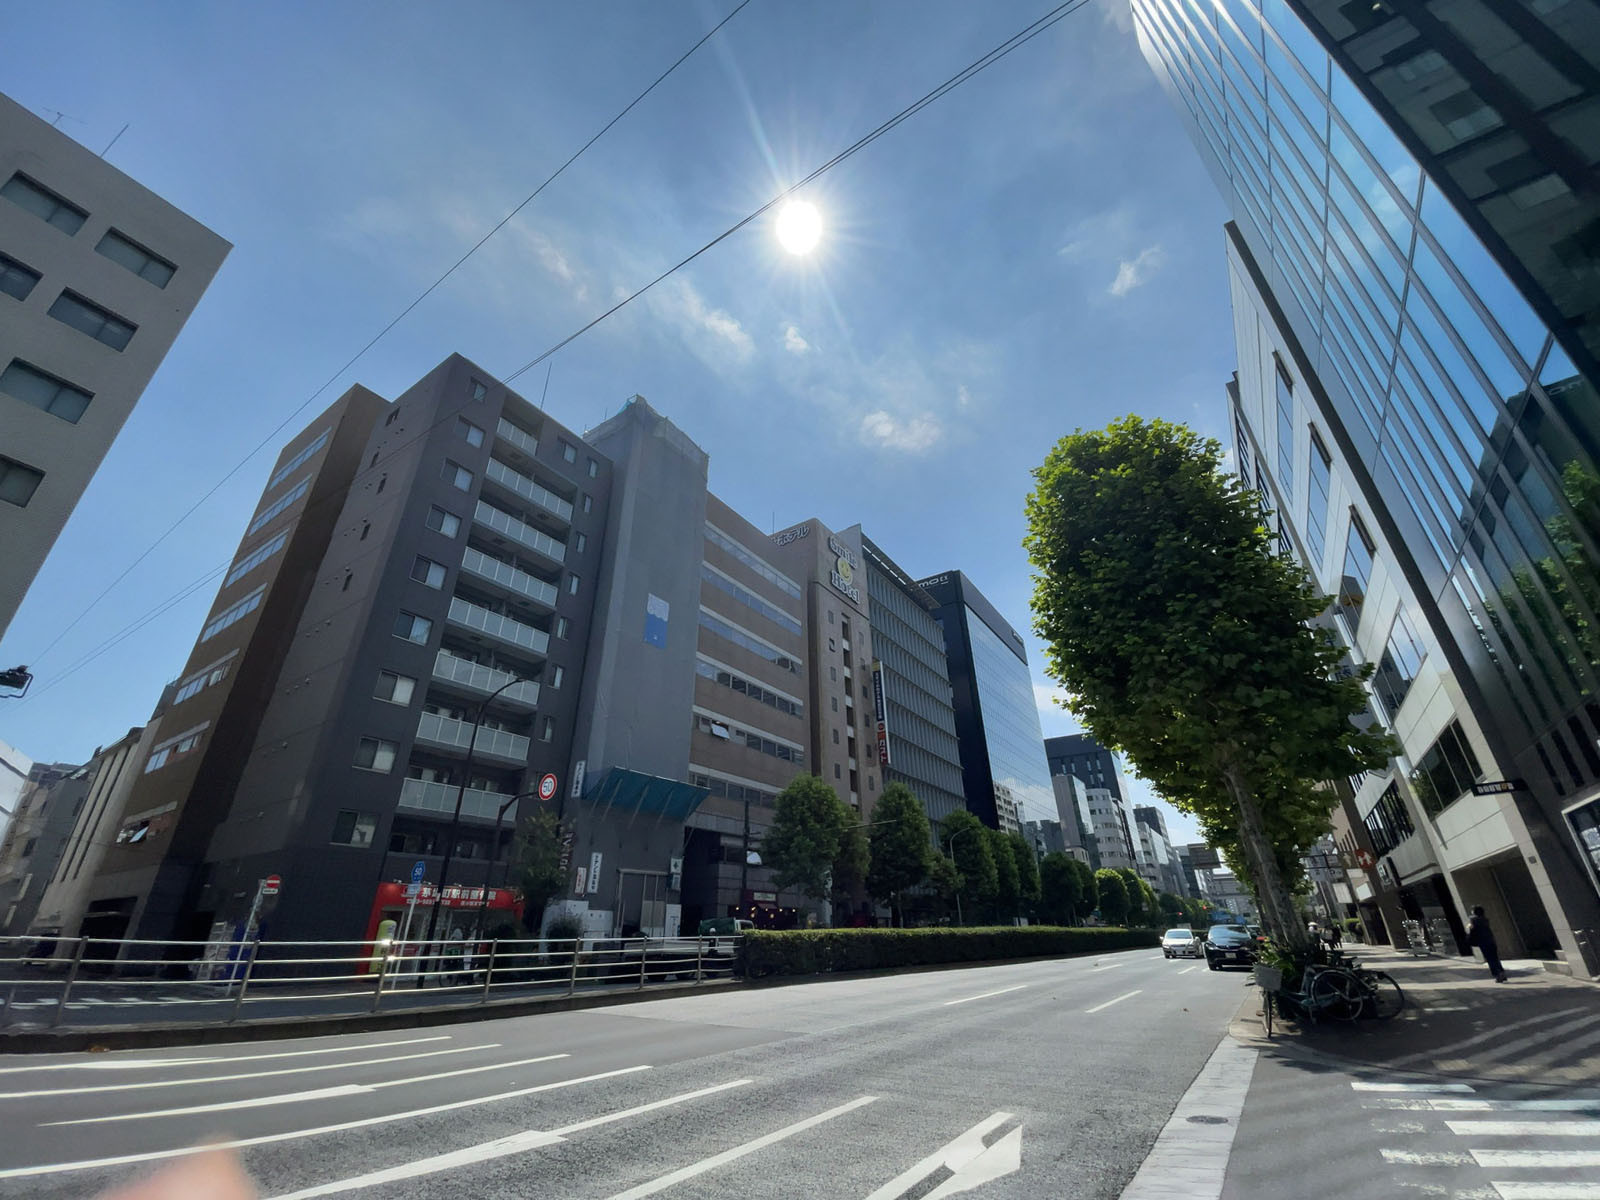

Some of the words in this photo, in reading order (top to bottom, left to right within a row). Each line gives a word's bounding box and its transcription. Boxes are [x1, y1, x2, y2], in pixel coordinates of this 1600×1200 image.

[829, 536, 858, 569] Smile
[831, 570, 860, 604] Hotel
[543, 780, 554, 793] 50
